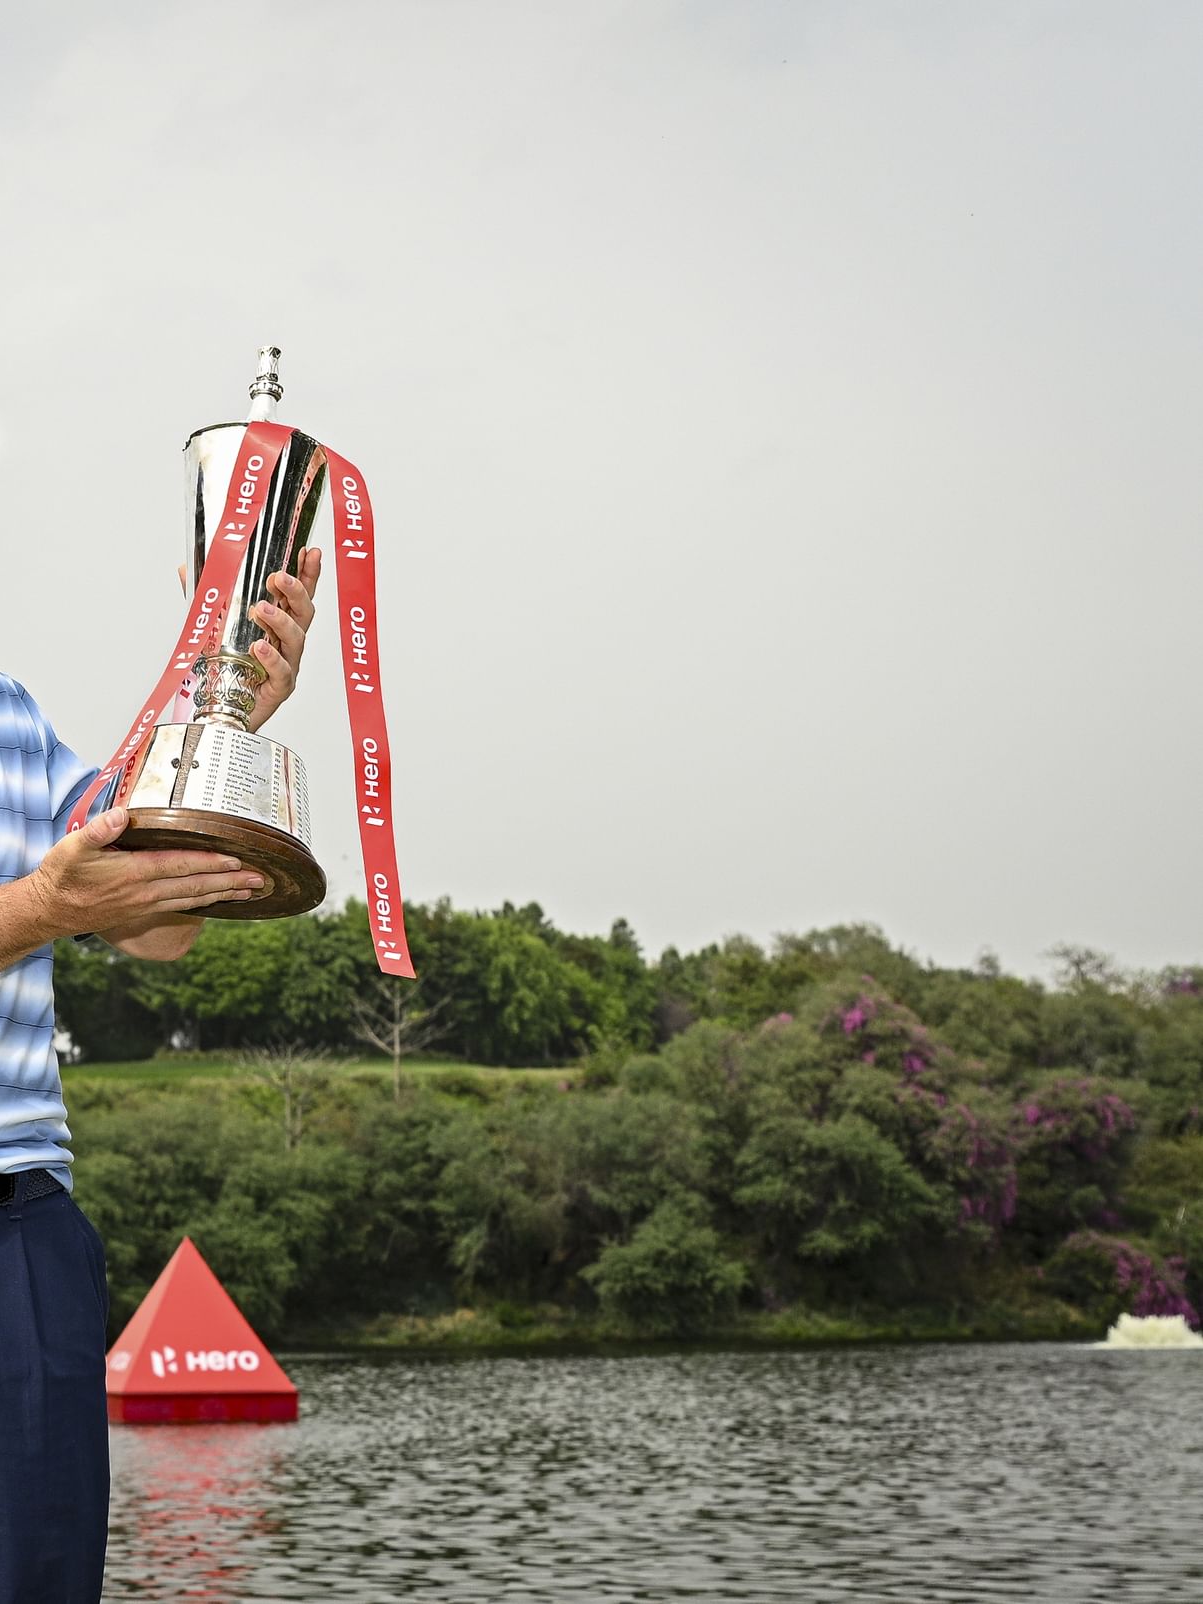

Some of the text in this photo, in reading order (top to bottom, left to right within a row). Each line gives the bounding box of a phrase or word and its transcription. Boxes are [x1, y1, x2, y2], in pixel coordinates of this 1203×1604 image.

[236, 455, 264, 514] Hero
[341, 476, 363, 531] Hero
[188, 587, 219, 644] Hero
[349, 606, 368, 665] Hero
[118, 709, 155, 760] Hero
[362, 737, 379, 797] Hero
[373, 873, 393, 933] Hero
[185, 1350, 260, 1372] Hero
